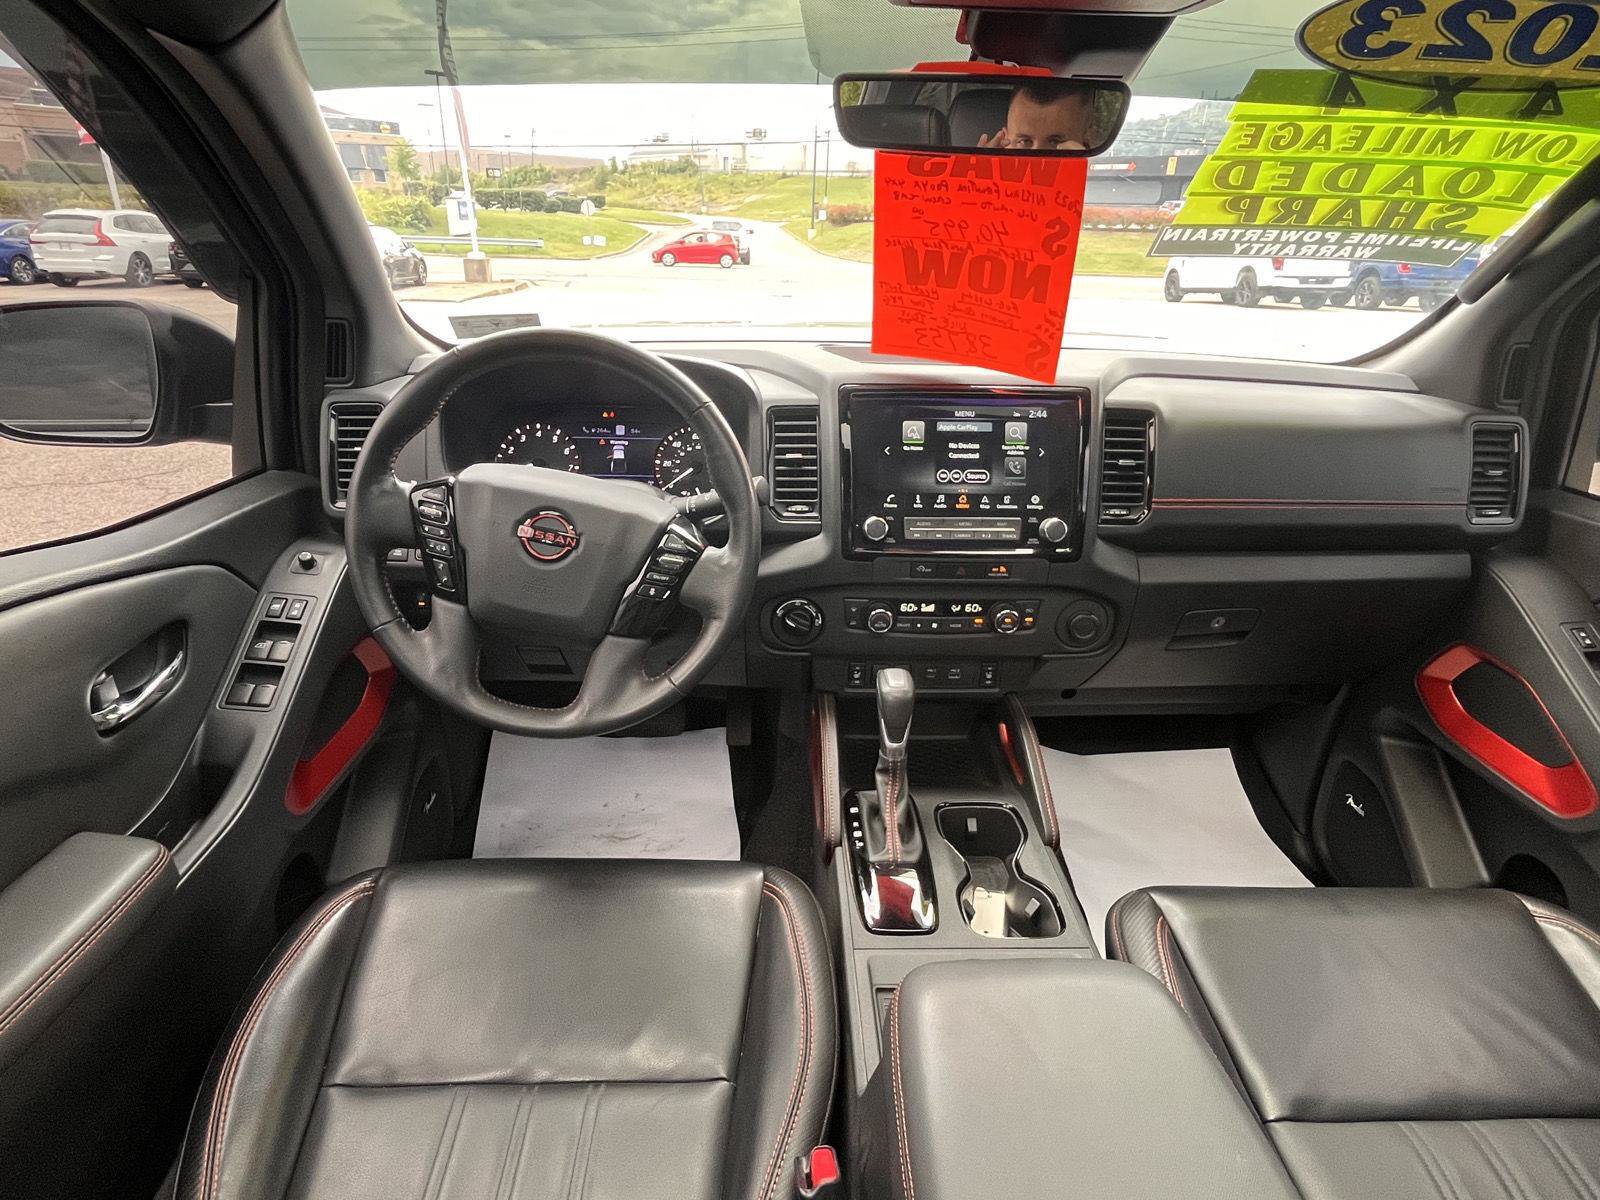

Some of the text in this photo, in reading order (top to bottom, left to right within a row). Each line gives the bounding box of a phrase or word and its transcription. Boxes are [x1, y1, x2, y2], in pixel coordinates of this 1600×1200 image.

[954, 410, 976, 418] MENU
[1028, 410, 1048, 419] 2:44
[966, 472, 987, 480] Source
[517, 524, 577, 548] NISSAN
